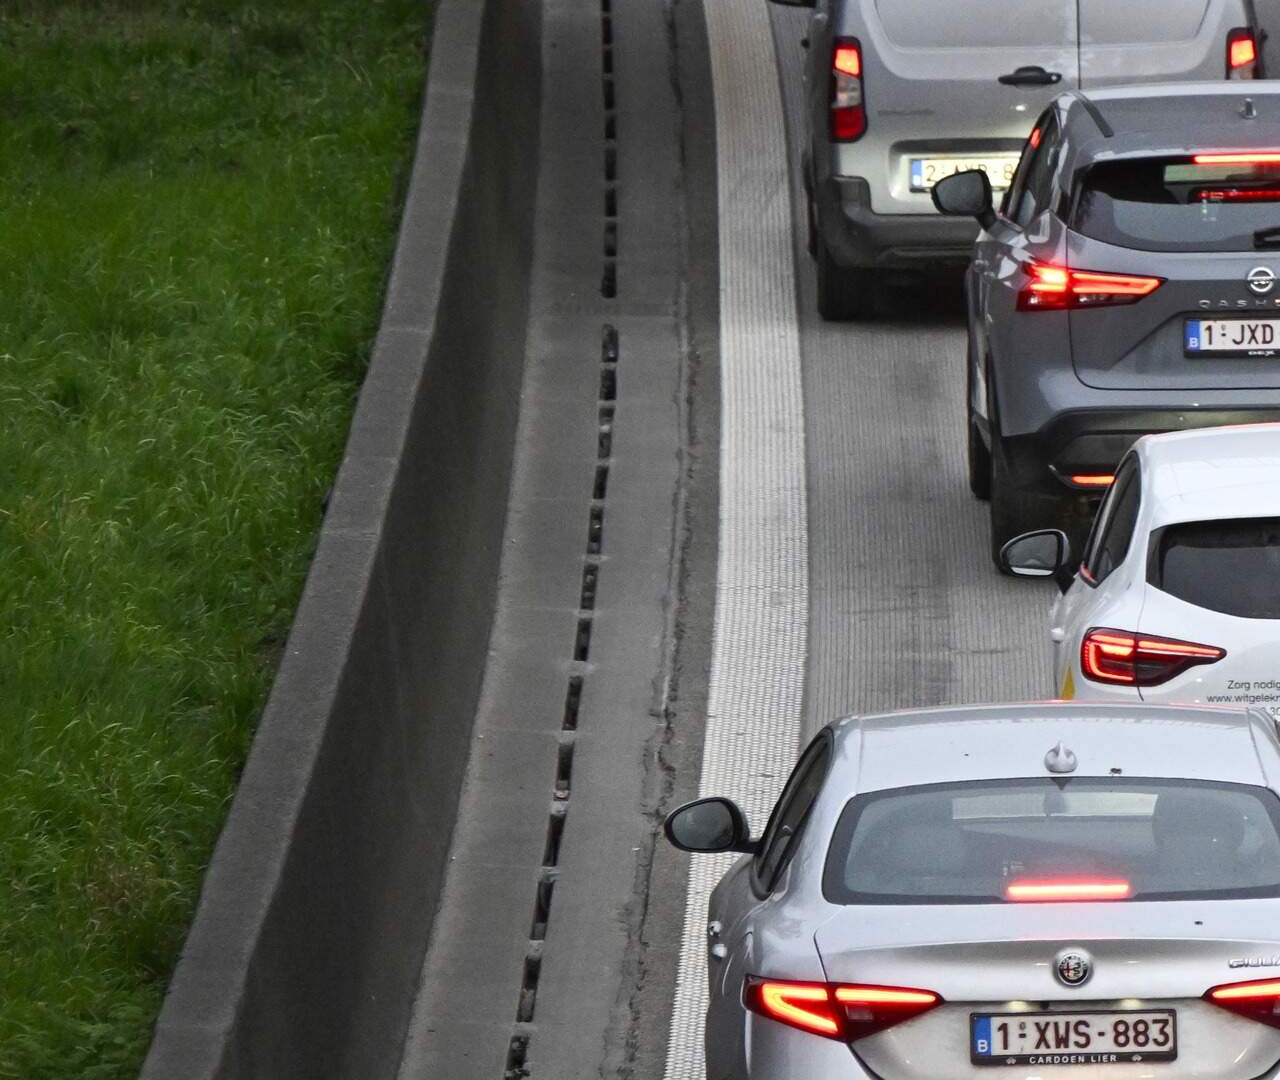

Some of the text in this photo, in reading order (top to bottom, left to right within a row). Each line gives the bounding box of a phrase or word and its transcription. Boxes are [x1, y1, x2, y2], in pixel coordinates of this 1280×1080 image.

[1227, 680, 1250, 691] Zorg
[977, 1019, 1171, 1052] B 1-XWS-883
[1029, 1054, 1118, 1065] CARDOEN LIER
